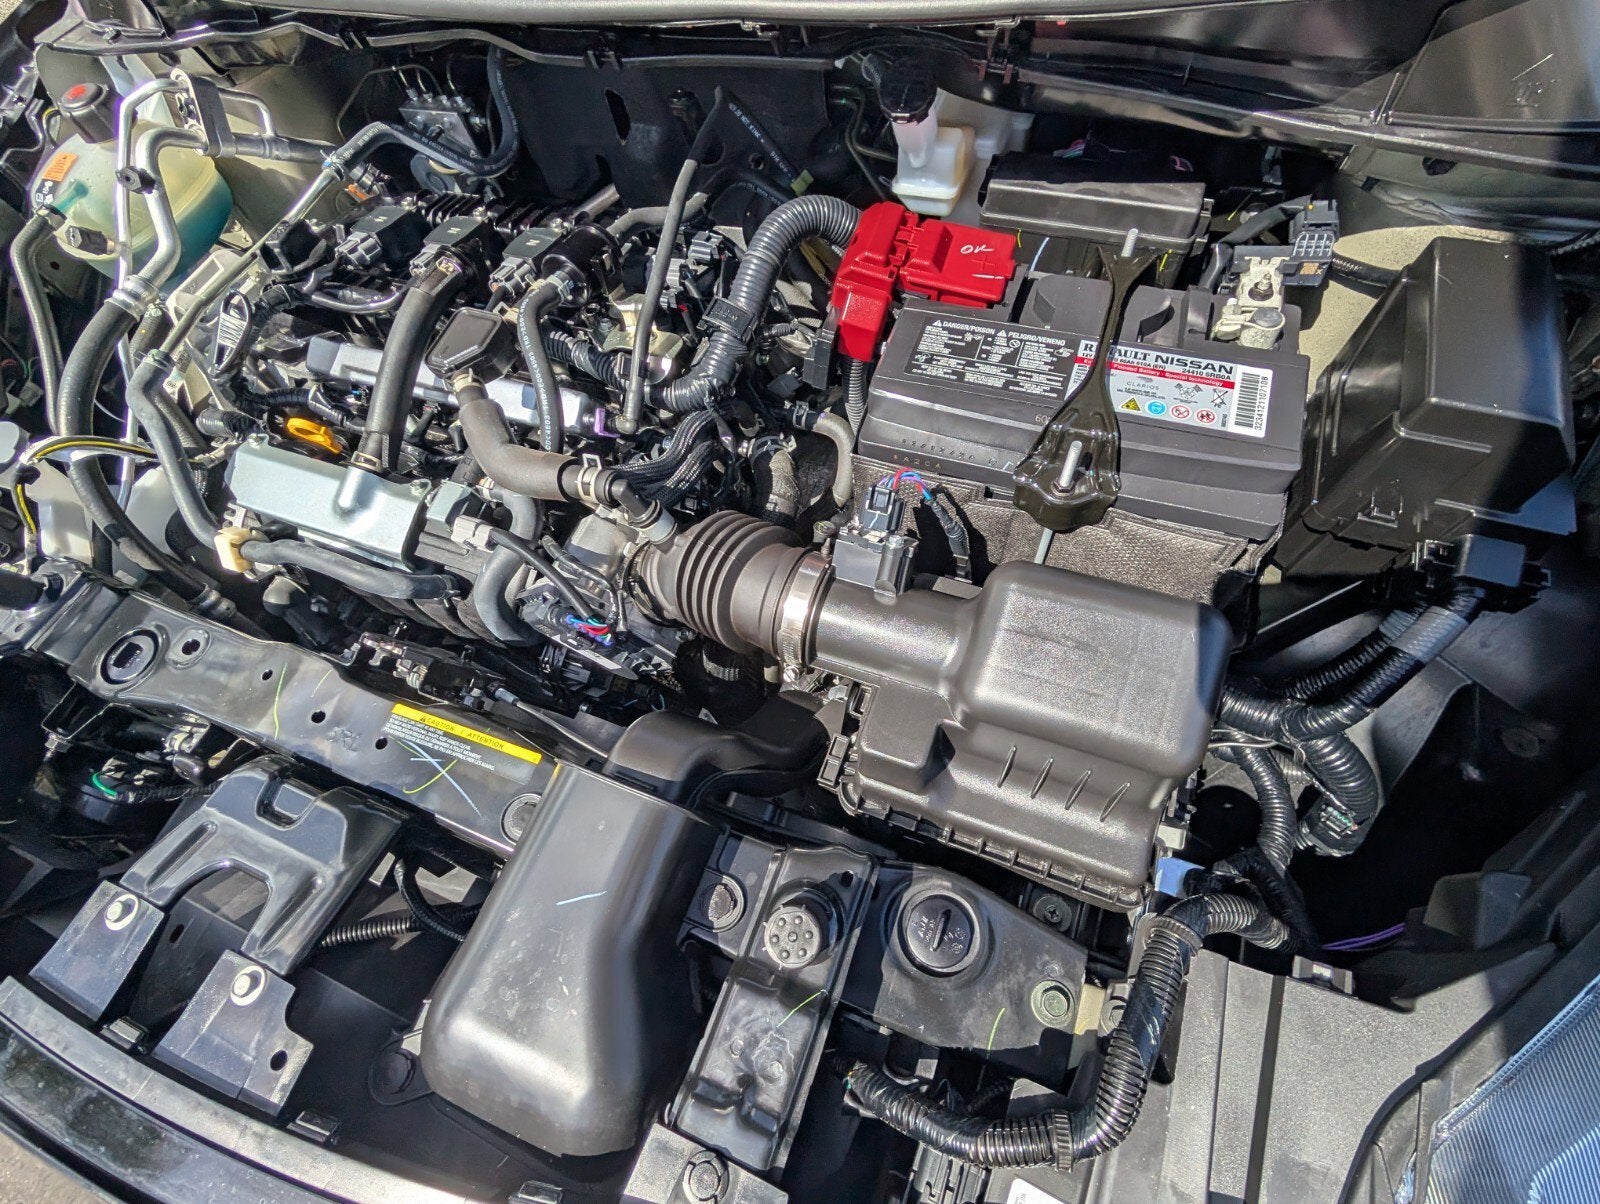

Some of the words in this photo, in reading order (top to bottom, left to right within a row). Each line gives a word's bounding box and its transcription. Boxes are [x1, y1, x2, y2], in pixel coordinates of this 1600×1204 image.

[943, 321, 995, 335] DANGER/POISON
[1008, 332, 1066, 346] PELIGRO/VENENO
[1154, 354, 1234, 375] NISSAN
[1126, 381, 1159, 390] CLARIOS
[1138, 367, 1160, 376] Battery
[1165, 372, 1188, 380] Special
[1188, 375, 1223, 387] technology
[427, 717, 454, 731] CAUTION
[468, 732, 505, 750] ATTENTION
